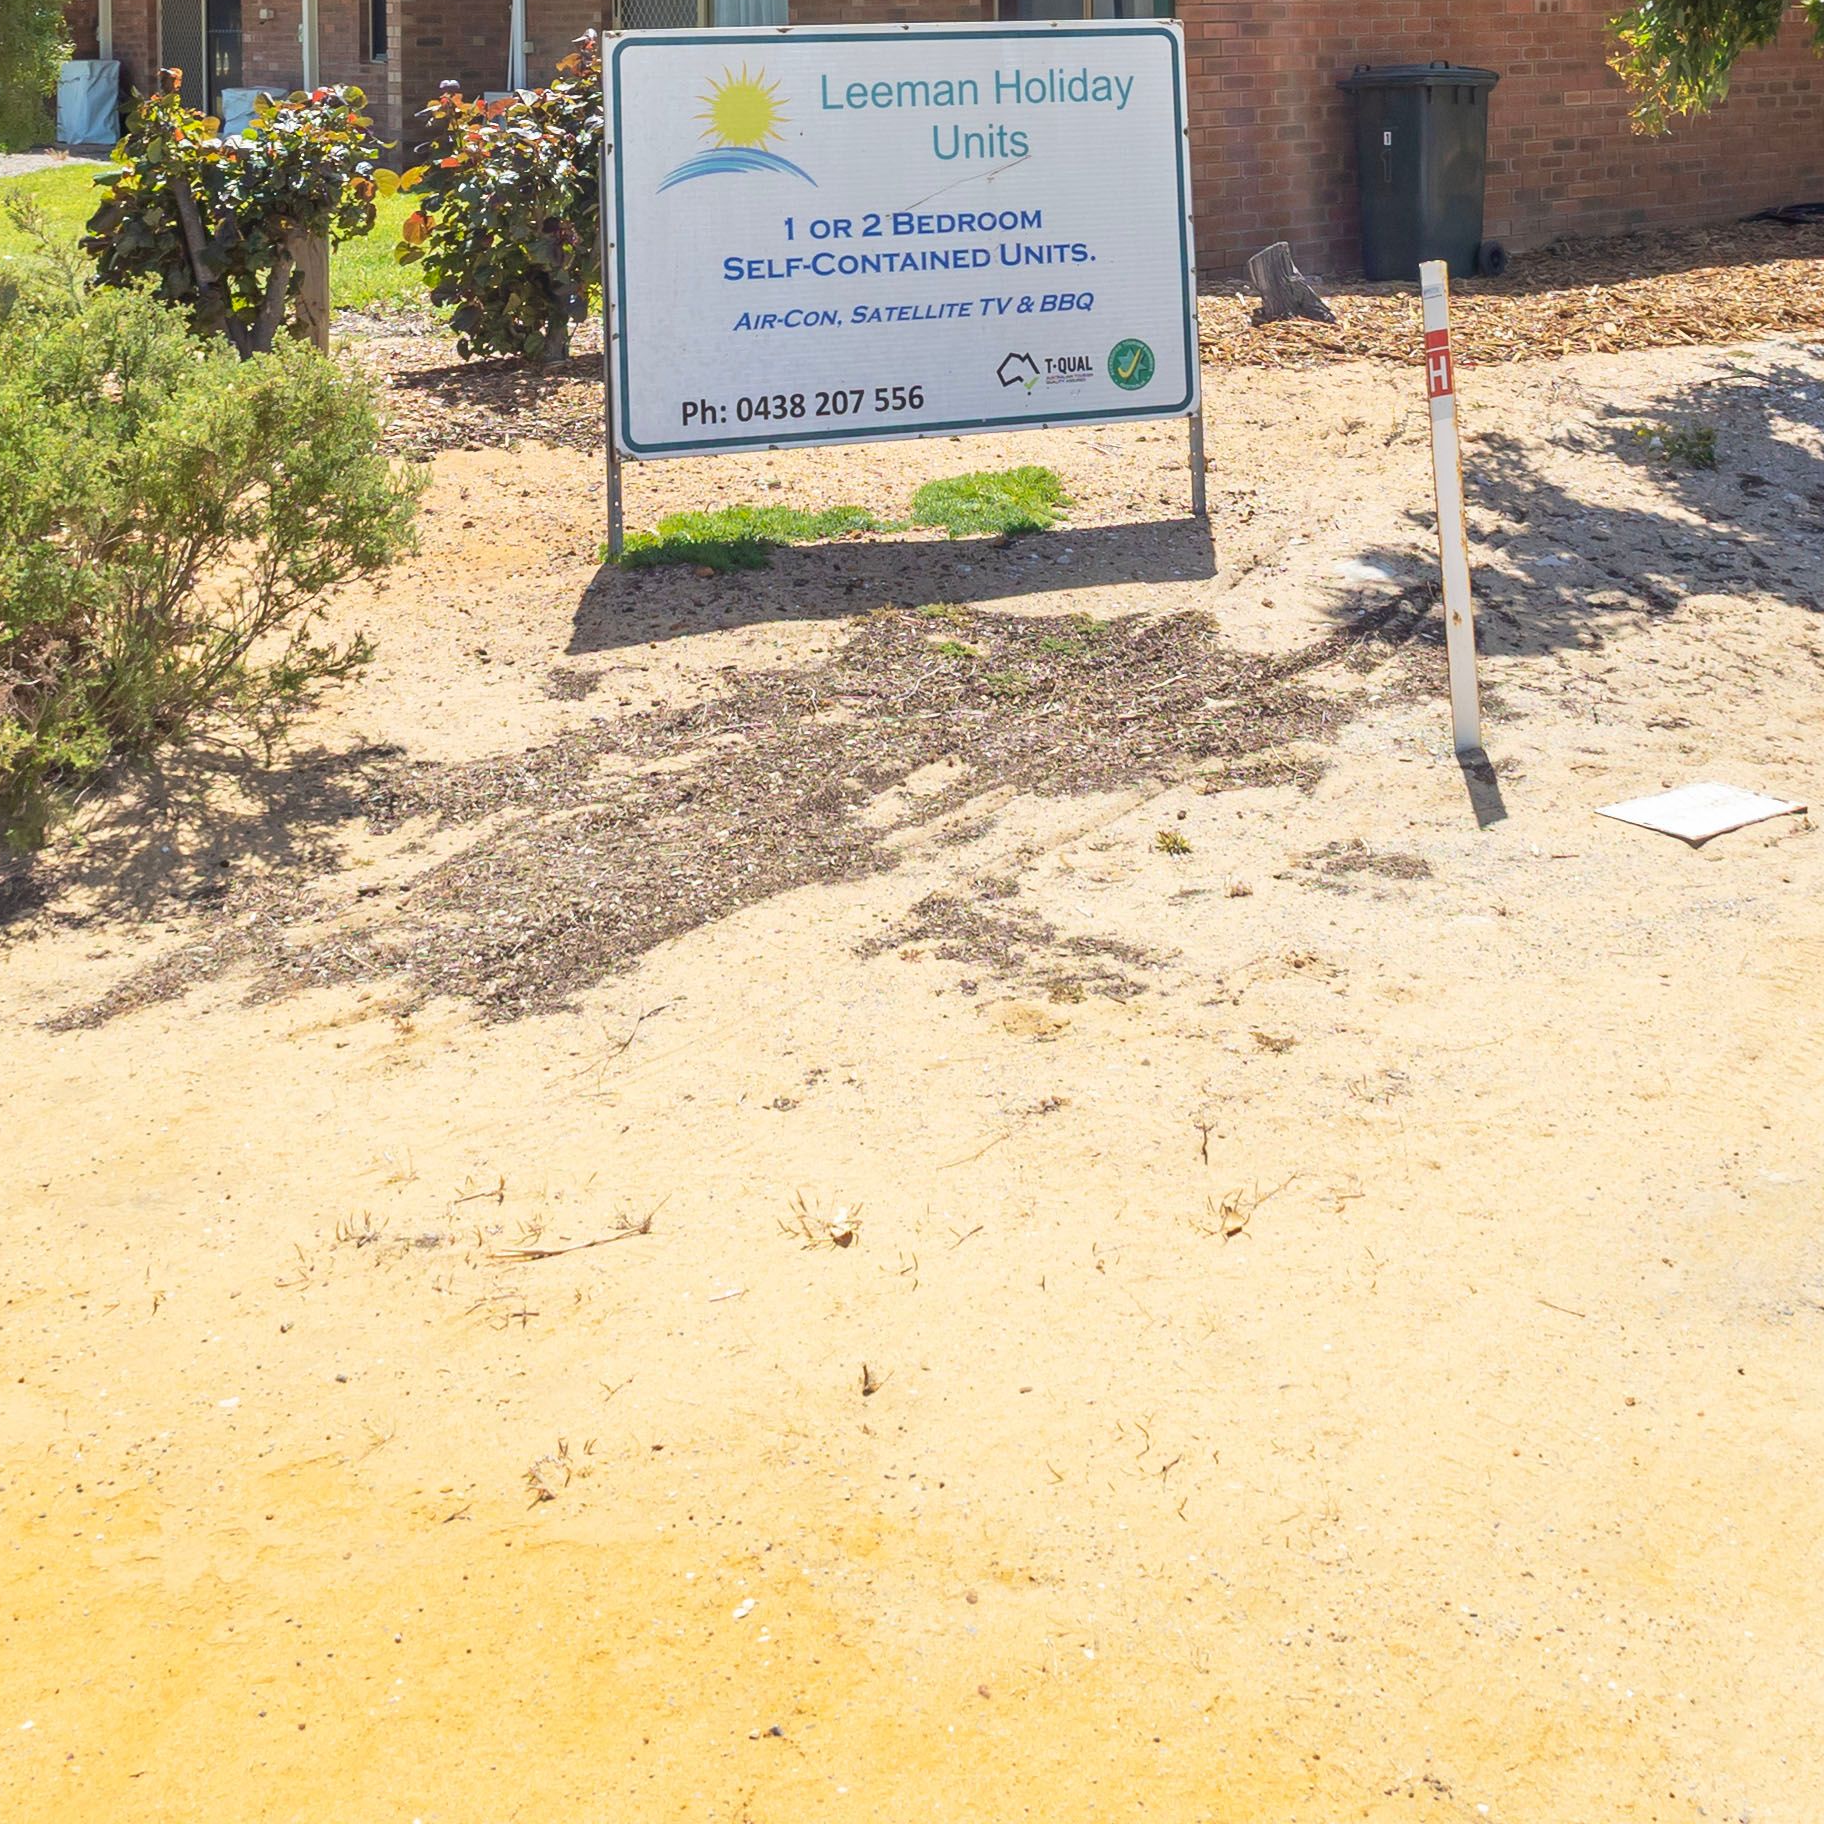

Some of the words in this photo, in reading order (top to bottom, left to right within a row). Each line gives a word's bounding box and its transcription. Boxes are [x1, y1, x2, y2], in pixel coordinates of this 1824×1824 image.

[821, 74, 979, 110] Leeman
[994, 68, 1134, 111] Holiday
[932, 124, 1030, 160] Units
[784, 217, 795, 241] 1
[861, 213, 883, 238] 2
[979, 296, 1013, 317] TV
[1016, 296, 1035, 314] &
[1039, 291, 1095, 313] BBQ
[1428, 355, 1449, 393] H
[681, 399, 727, 427] Ph:
[736, 394, 807, 423] 0438
[814, 389, 865, 417] 207
[874, 385, 925, 413] 556
